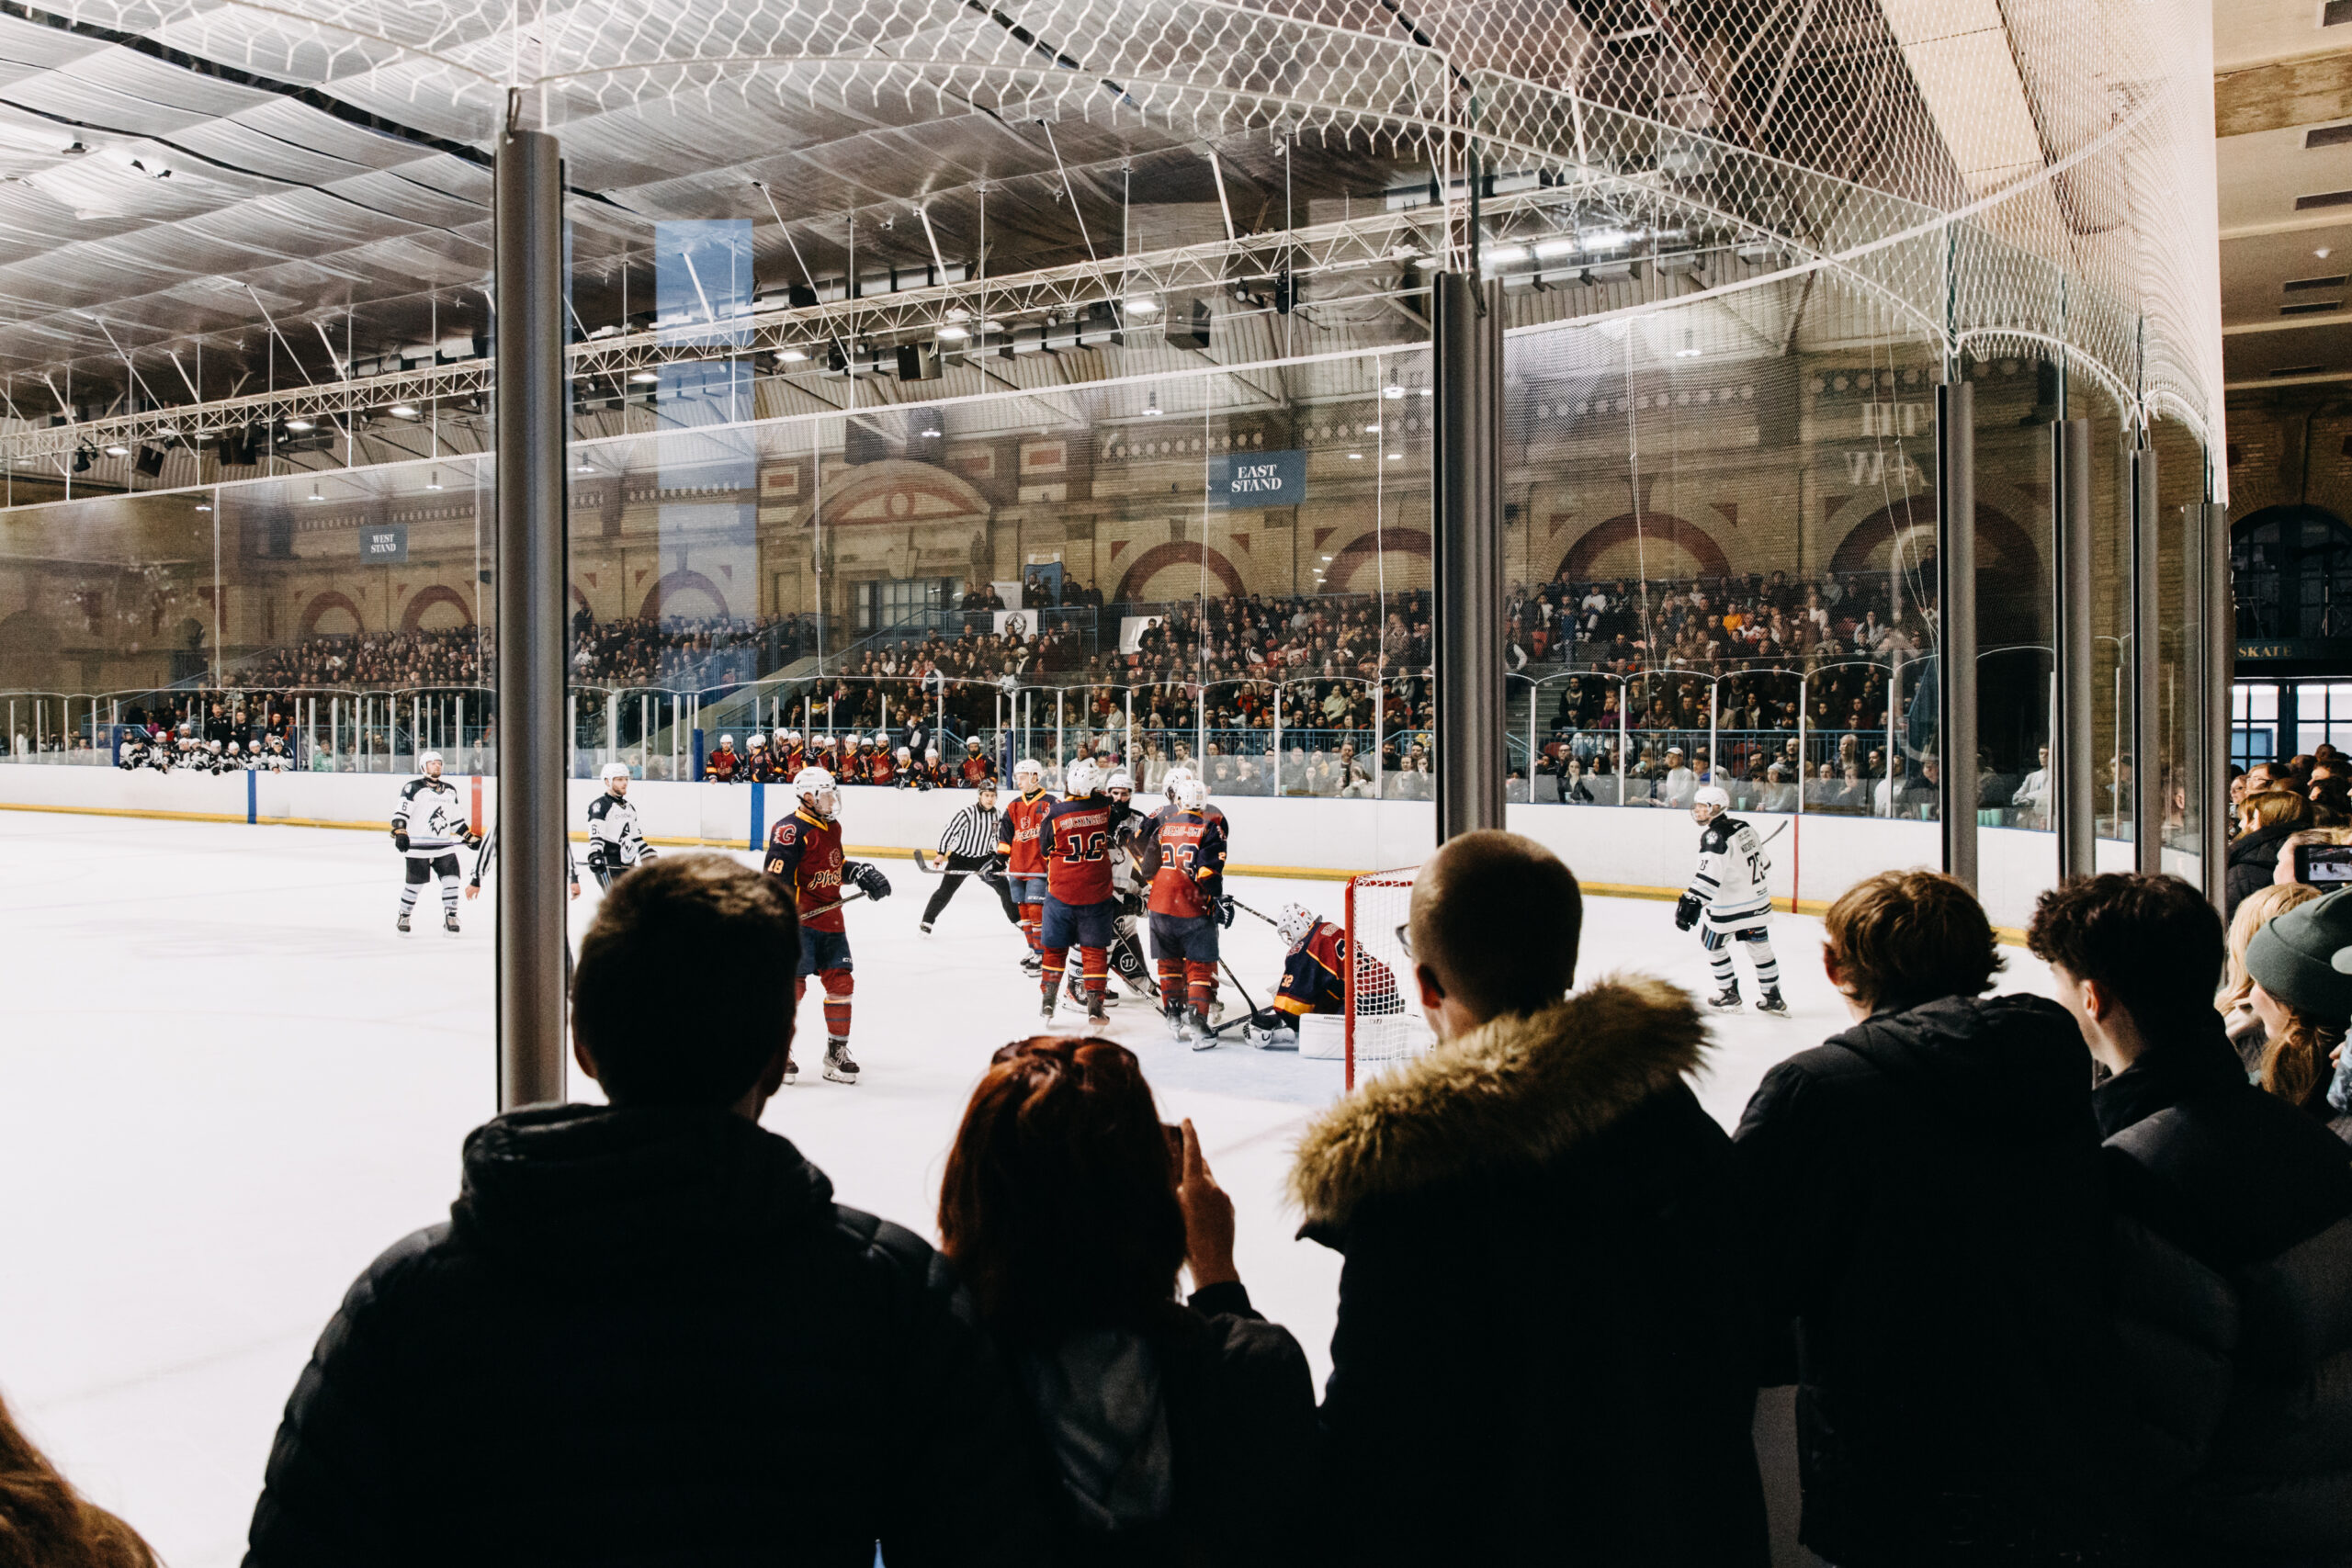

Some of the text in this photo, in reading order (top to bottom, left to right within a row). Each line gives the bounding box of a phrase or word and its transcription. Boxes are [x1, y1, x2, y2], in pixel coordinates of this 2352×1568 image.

[1238, 464, 1277, 479] EAST
[1231, 478, 1283, 493] STAND
[372, 534, 394, 543] WEST
[370, 544, 396, 553] STAND
[2238, 646, 2292, 658] SKATE
